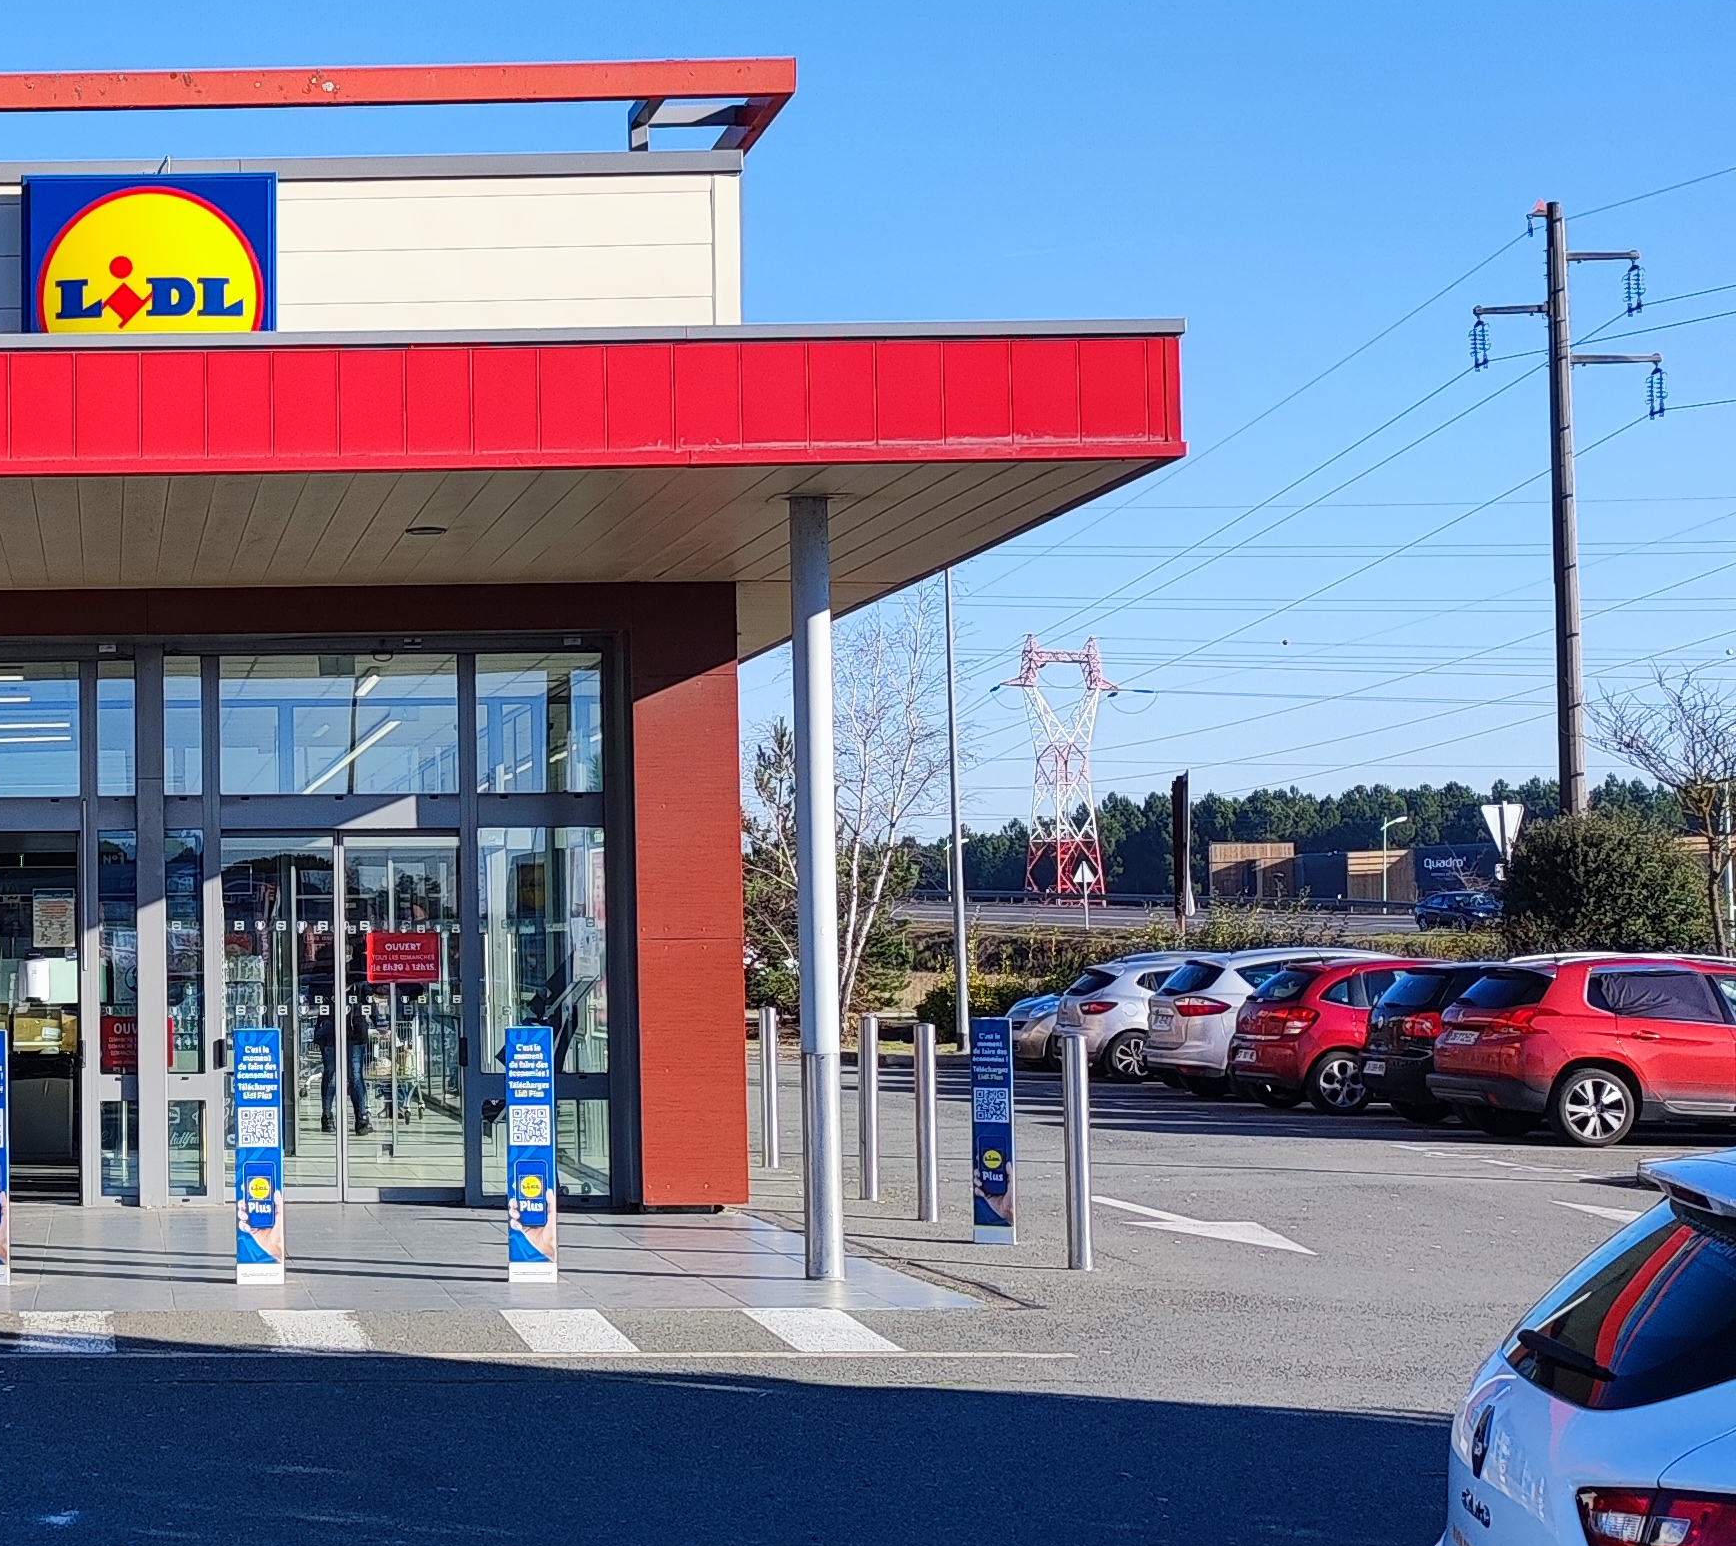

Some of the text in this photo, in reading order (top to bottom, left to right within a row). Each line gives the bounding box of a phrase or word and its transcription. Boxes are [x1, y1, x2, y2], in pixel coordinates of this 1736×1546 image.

[385, 943, 422, 951] OUVERT
[982, 1171, 1004, 1181] Plus
[248, 1202, 272, 1213] Plus
[520, 1200, 544, 1212] Plus
